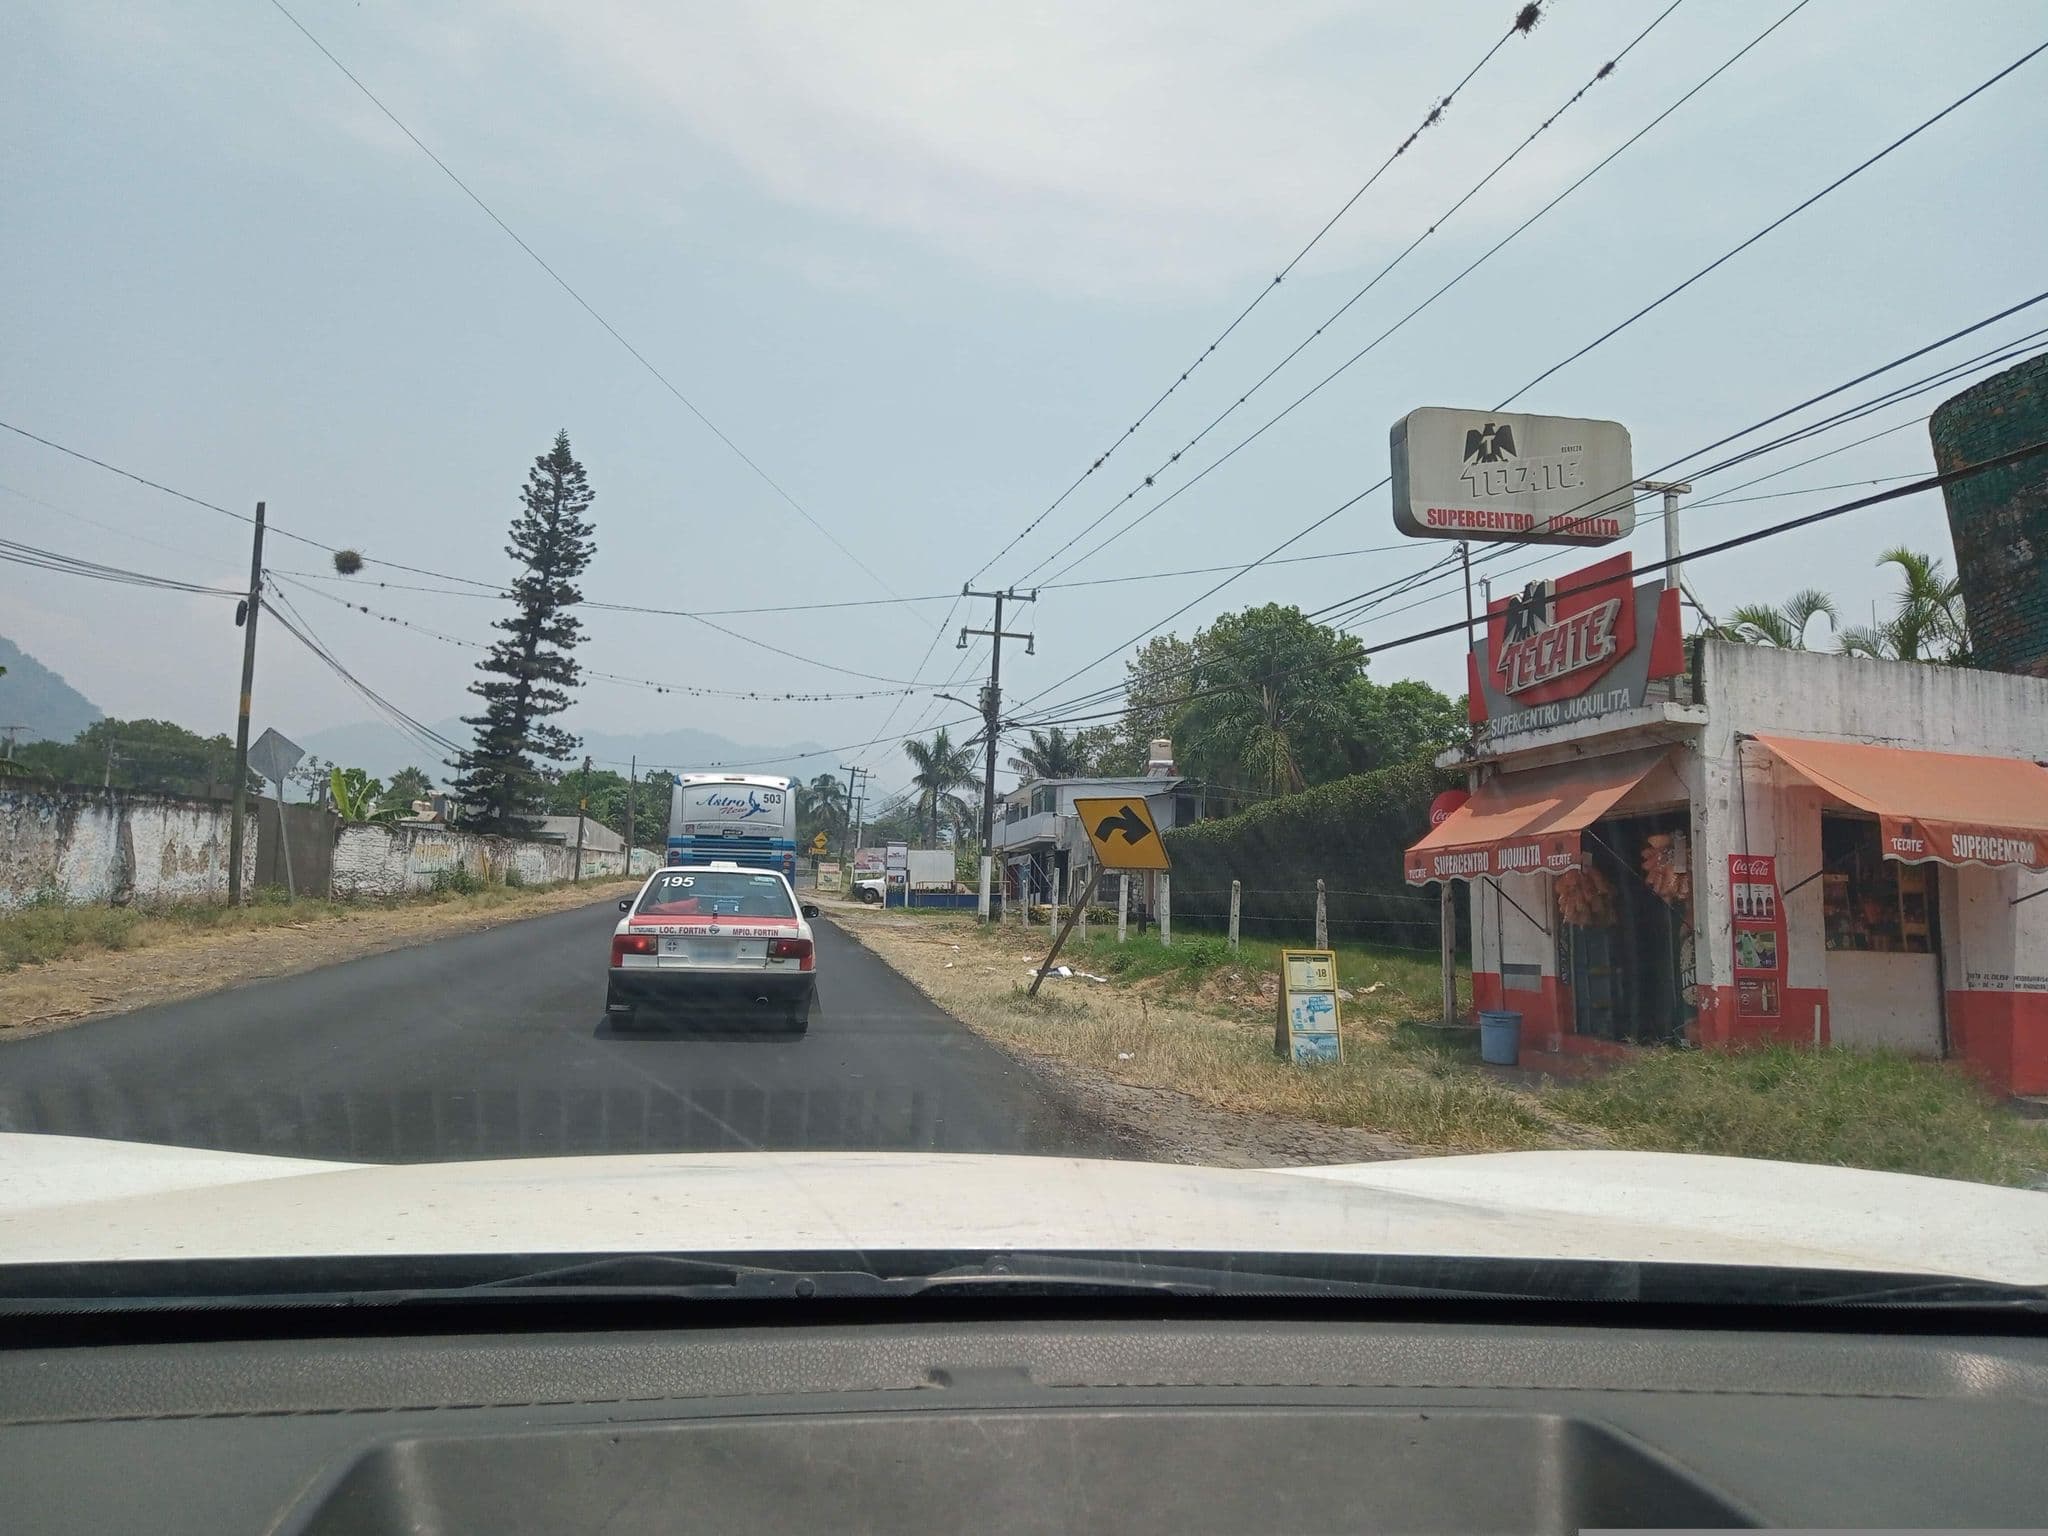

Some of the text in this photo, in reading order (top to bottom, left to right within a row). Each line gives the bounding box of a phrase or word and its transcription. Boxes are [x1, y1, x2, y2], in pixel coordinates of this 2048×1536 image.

[1427, 508, 1620, 537] SUPERCENTRO JUQUILITA
[1496, 602, 1613, 696] TECATE
[1491, 687, 1631, 738] SUPERCENTRO JUQUILITA
[696, 793, 746, 807] Astro
[763, 793, 782, 804] 503
[1891, 833, 2037, 865] TECATE SUPERCENTRO
[1434, 851, 1489, 876] SUPERCENTRO
[1547, 852, 1572, 867] TECATE
[661, 876, 696, 888] 195
[659, 926, 677, 935] LOC.
[679, 926, 707, 935] FORTIN
